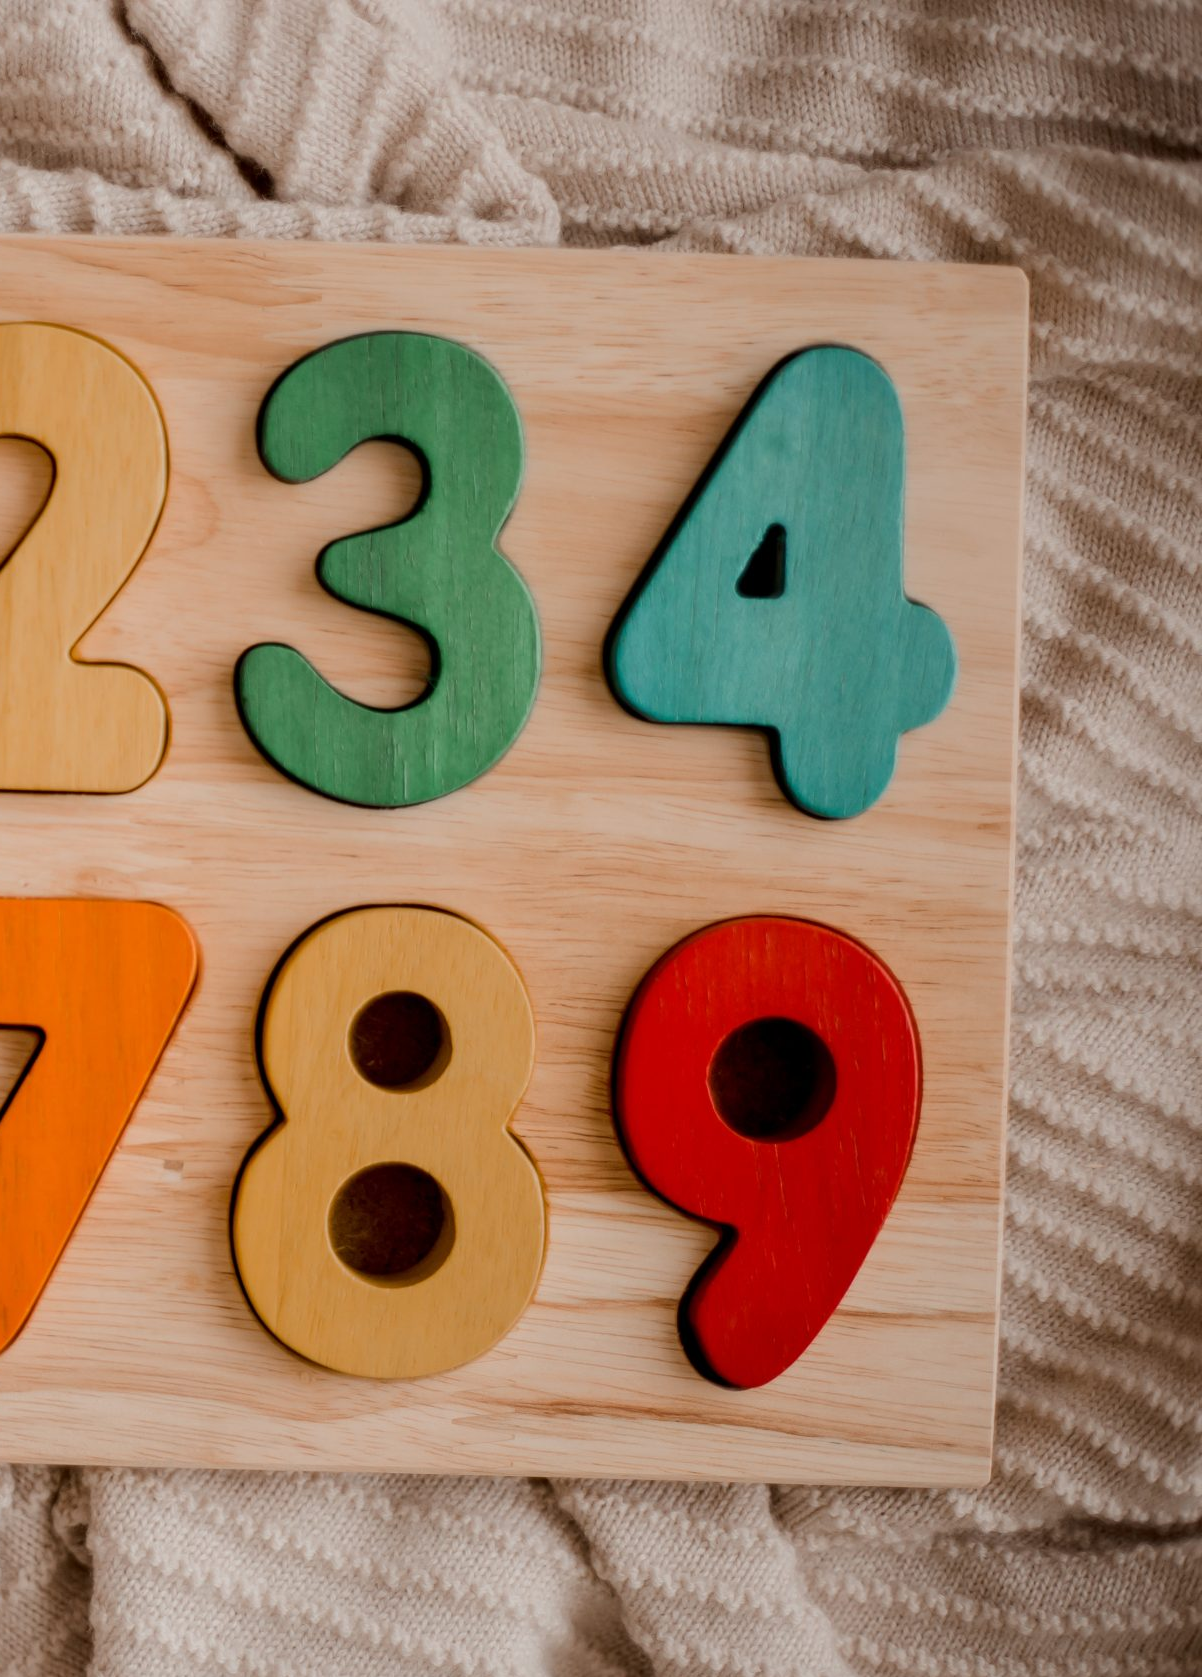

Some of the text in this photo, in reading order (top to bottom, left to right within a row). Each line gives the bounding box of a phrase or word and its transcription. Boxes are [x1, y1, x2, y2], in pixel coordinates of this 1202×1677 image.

[234, 331, 543, 808] 3
[604, 345, 957, 819] 4
[231, 906, 548, 1379] 8
[613, 915, 923, 1389] 9
